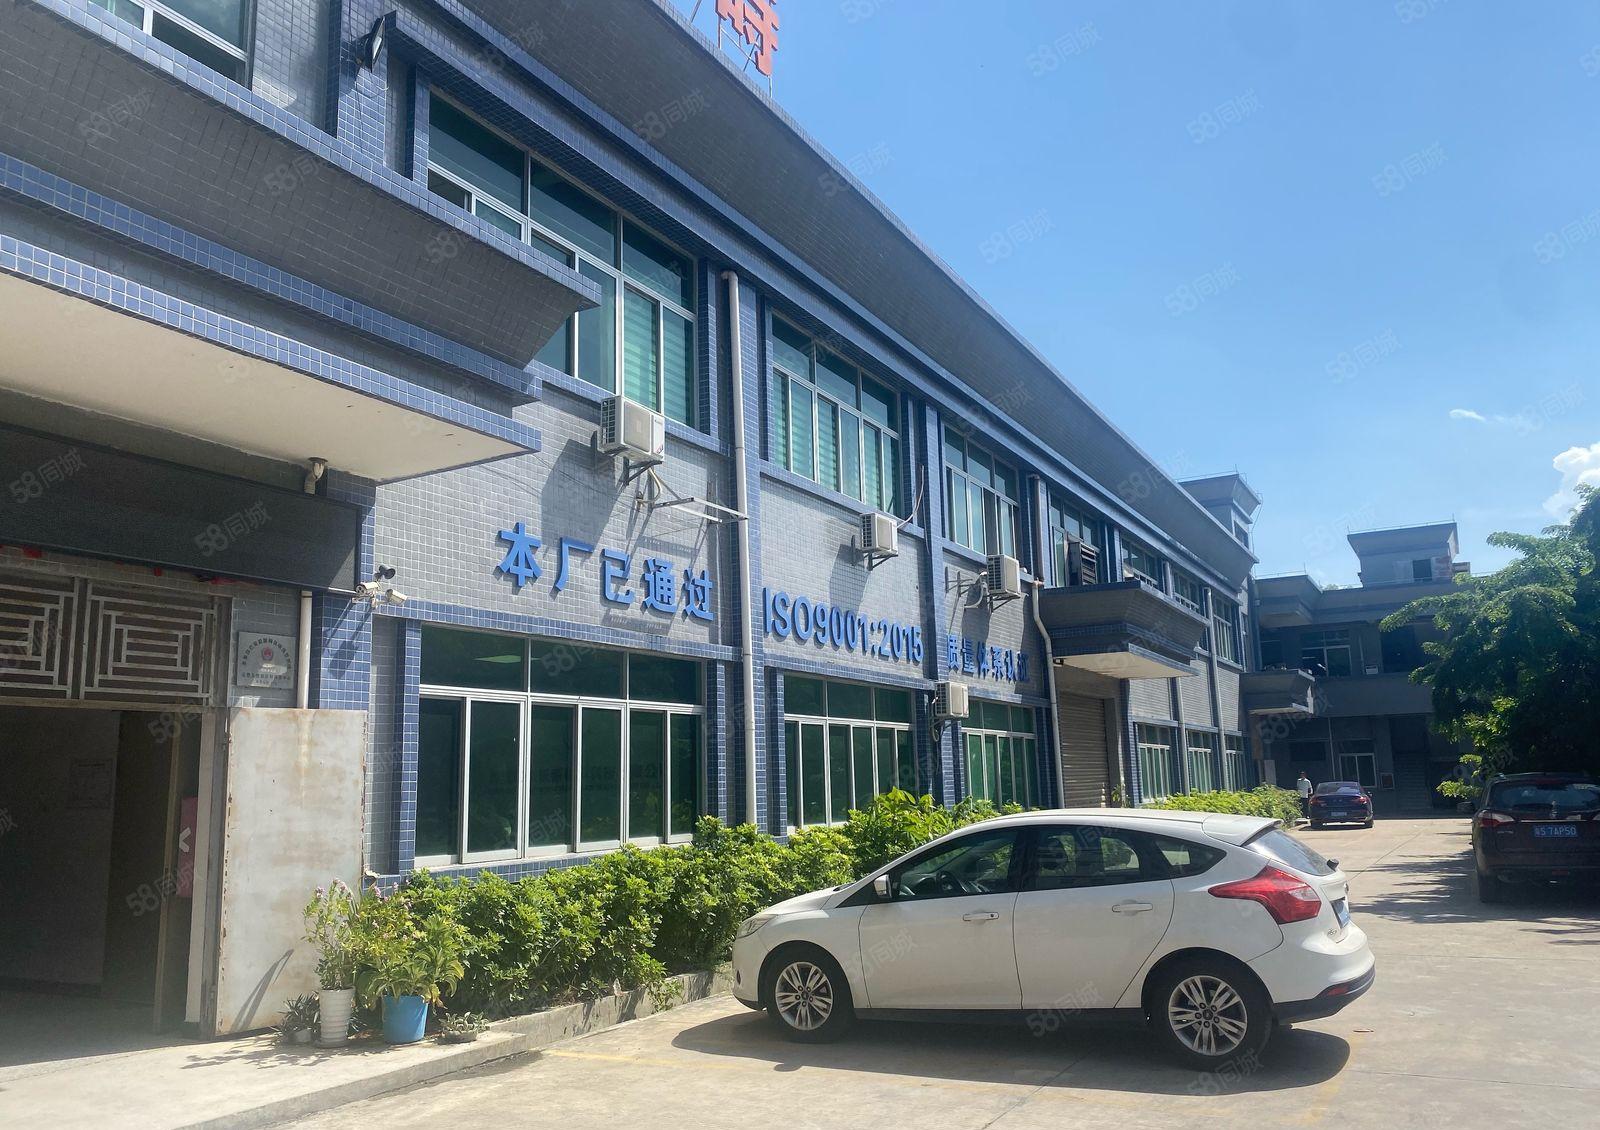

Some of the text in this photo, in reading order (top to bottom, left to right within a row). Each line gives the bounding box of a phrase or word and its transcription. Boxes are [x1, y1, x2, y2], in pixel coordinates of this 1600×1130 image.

[498, 521, 714, 620] 本厂已通过
[763, 587, 924, 664] ISO9001:2015
